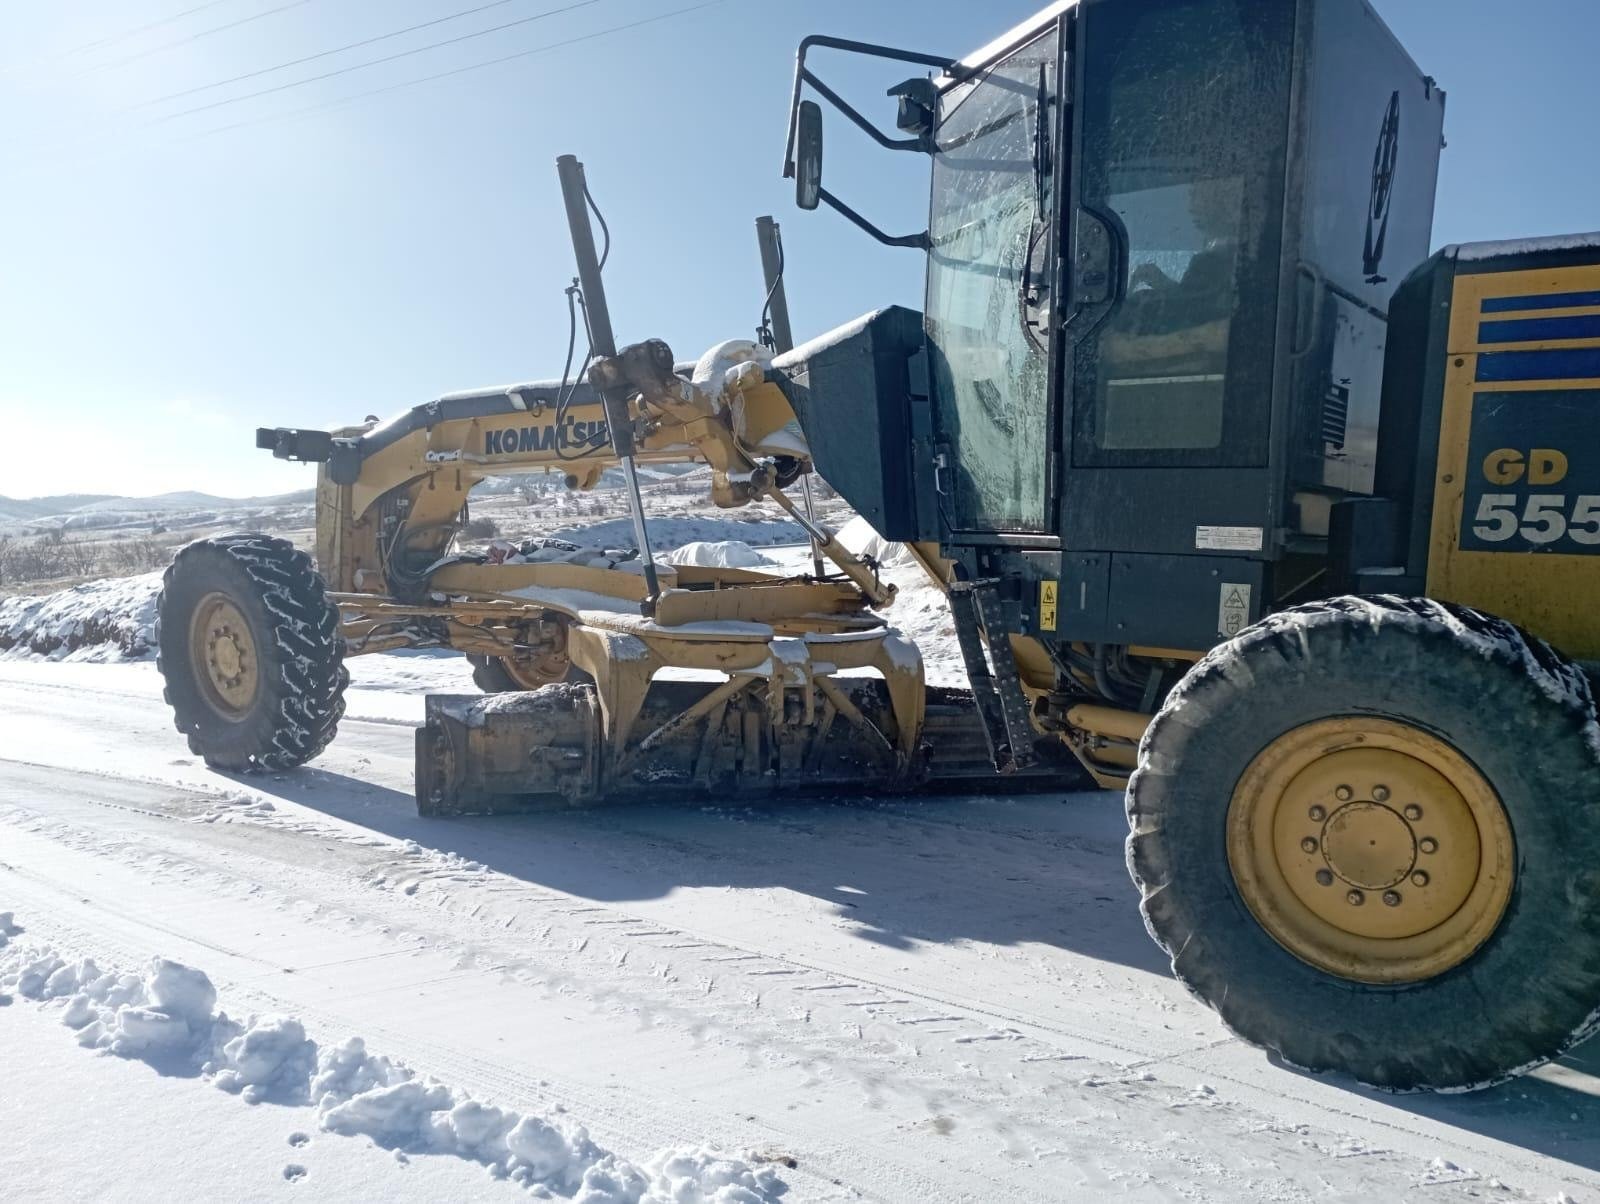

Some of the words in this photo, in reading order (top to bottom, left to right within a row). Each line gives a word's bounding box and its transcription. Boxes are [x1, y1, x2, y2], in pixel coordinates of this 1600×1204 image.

[485, 415, 609, 455] KOMATSU
[1483, 448, 1568, 485] GD
[1472, 494, 1600, 545] 555
